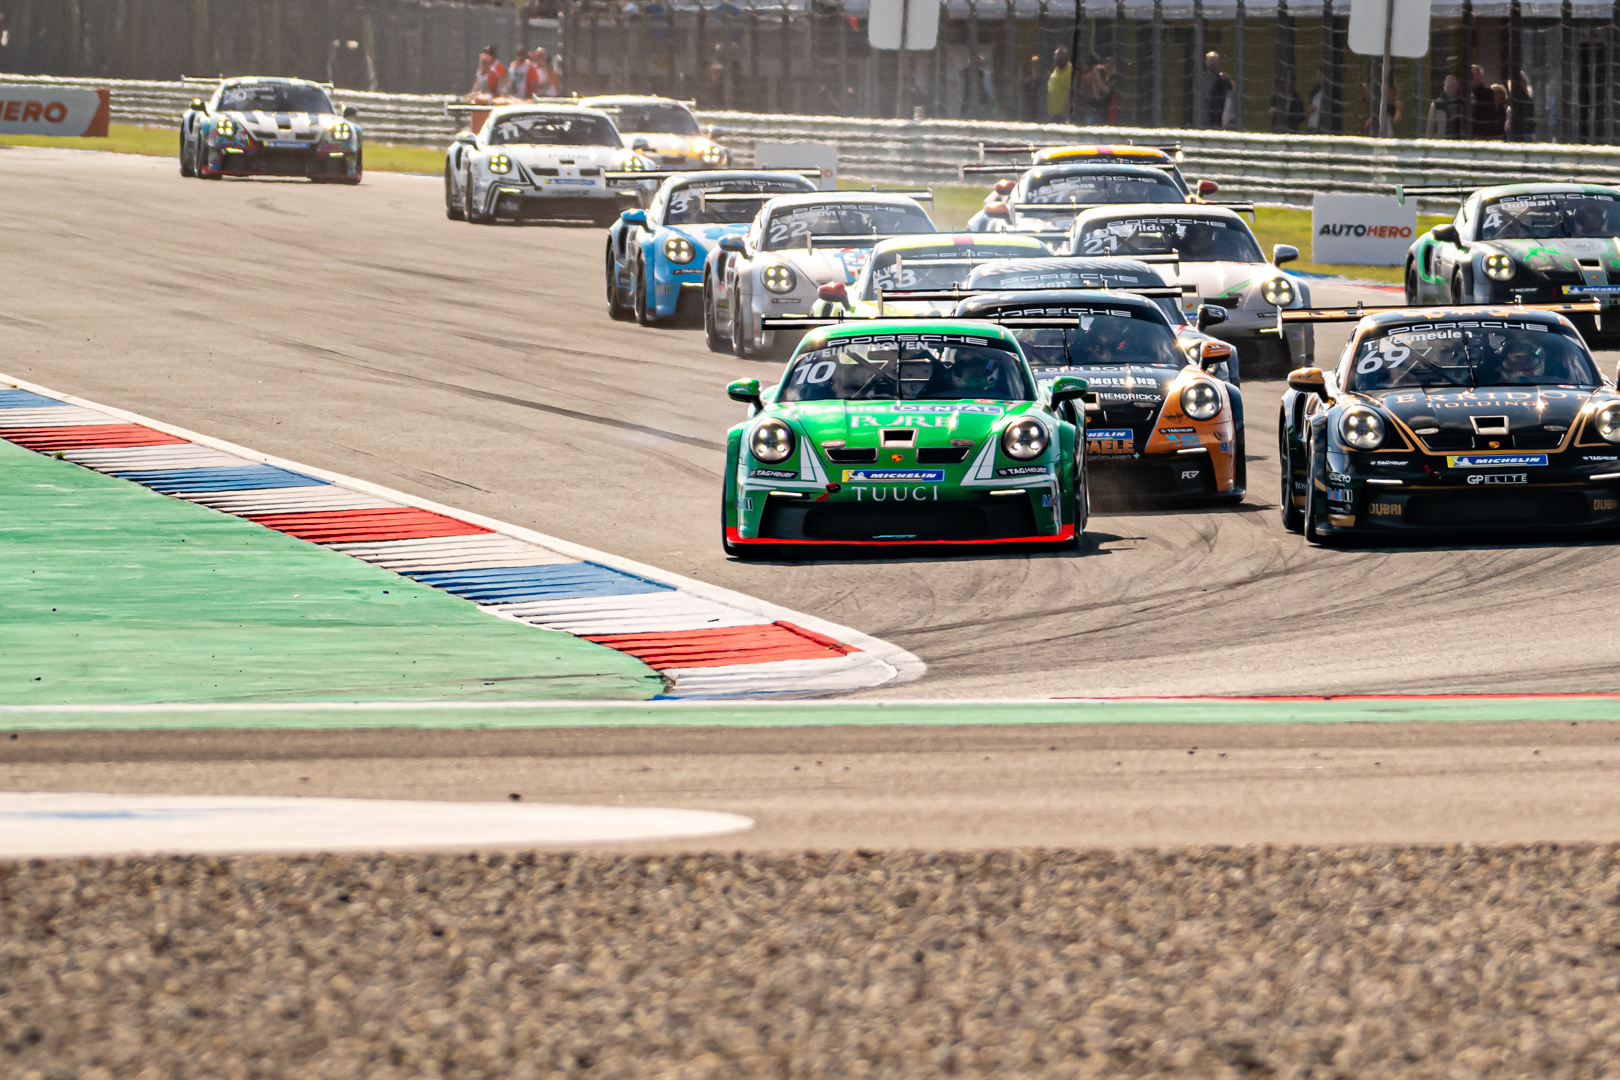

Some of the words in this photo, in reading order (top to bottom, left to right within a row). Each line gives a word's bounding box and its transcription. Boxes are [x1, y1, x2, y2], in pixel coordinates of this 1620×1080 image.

[670, 199, 690, 214] 3
[1483, 213, 1503, 229] 4
[769, 221, 808, 243] 22
[1319, 223, 1412, 238] AUTOHERO
[1083, 235, 1118, 255] 21
[1000, 273, 1139, 286] PORSCHE
[1388, 321, 1549, 336] PORSCHE
[827, 334, 988, 348] PORSCHE
[1364, 340, 1378, 351] T.
[1386, 329, 1473, 346] Vermeulen
[1357, 347, 1411, 375] 69
[794, 360, 837, 385] 10
[1100, 392, 1162, 401] HENDRICKX
[900, 405, 998, 413] DENTAL
[1466, 474, 1484, 484] GP
[851, 485, 939, 502] TUUCI
